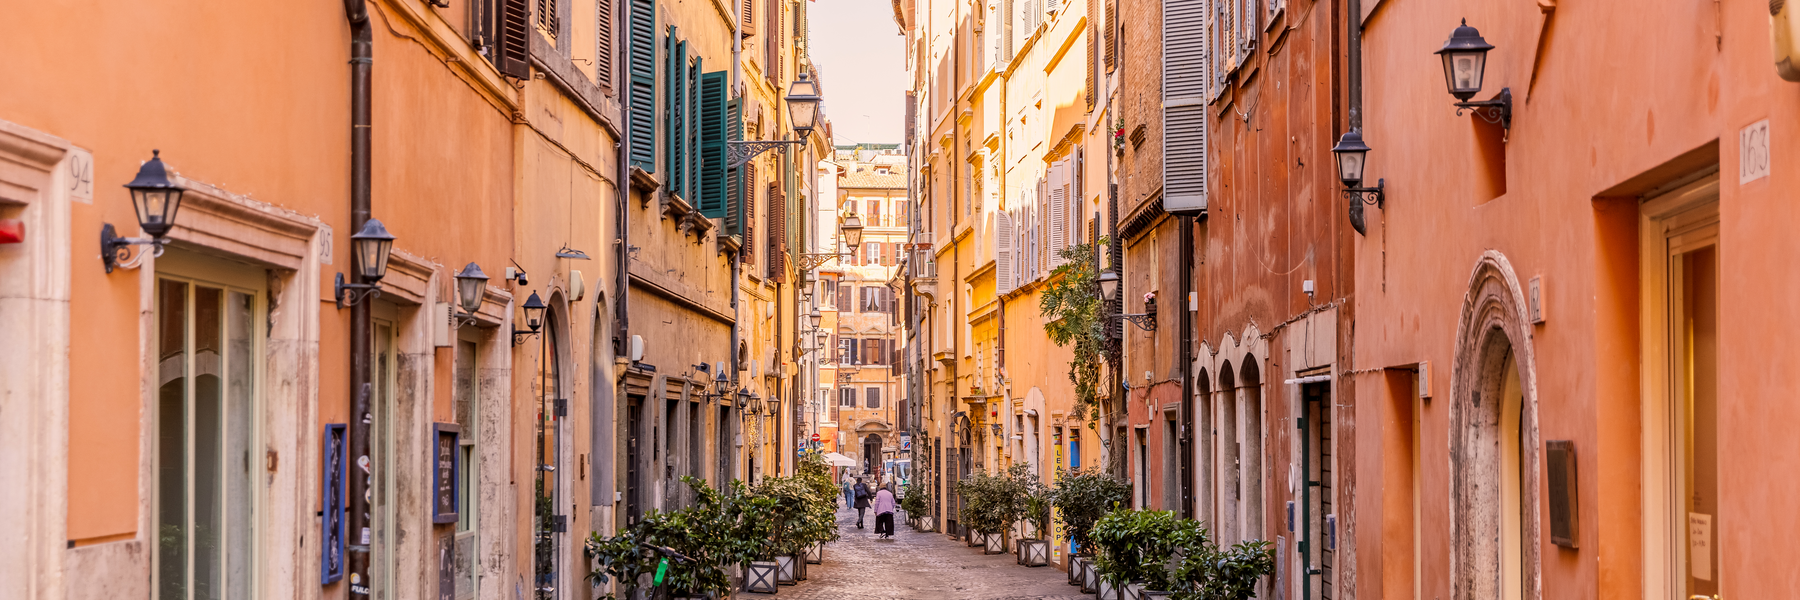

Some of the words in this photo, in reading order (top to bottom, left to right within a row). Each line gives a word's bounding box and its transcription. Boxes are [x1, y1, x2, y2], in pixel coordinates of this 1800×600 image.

[1742, 125, 1768, 178] 163
[70, 155, 90, 194] 94
[320, 229, 331, 257] 95
